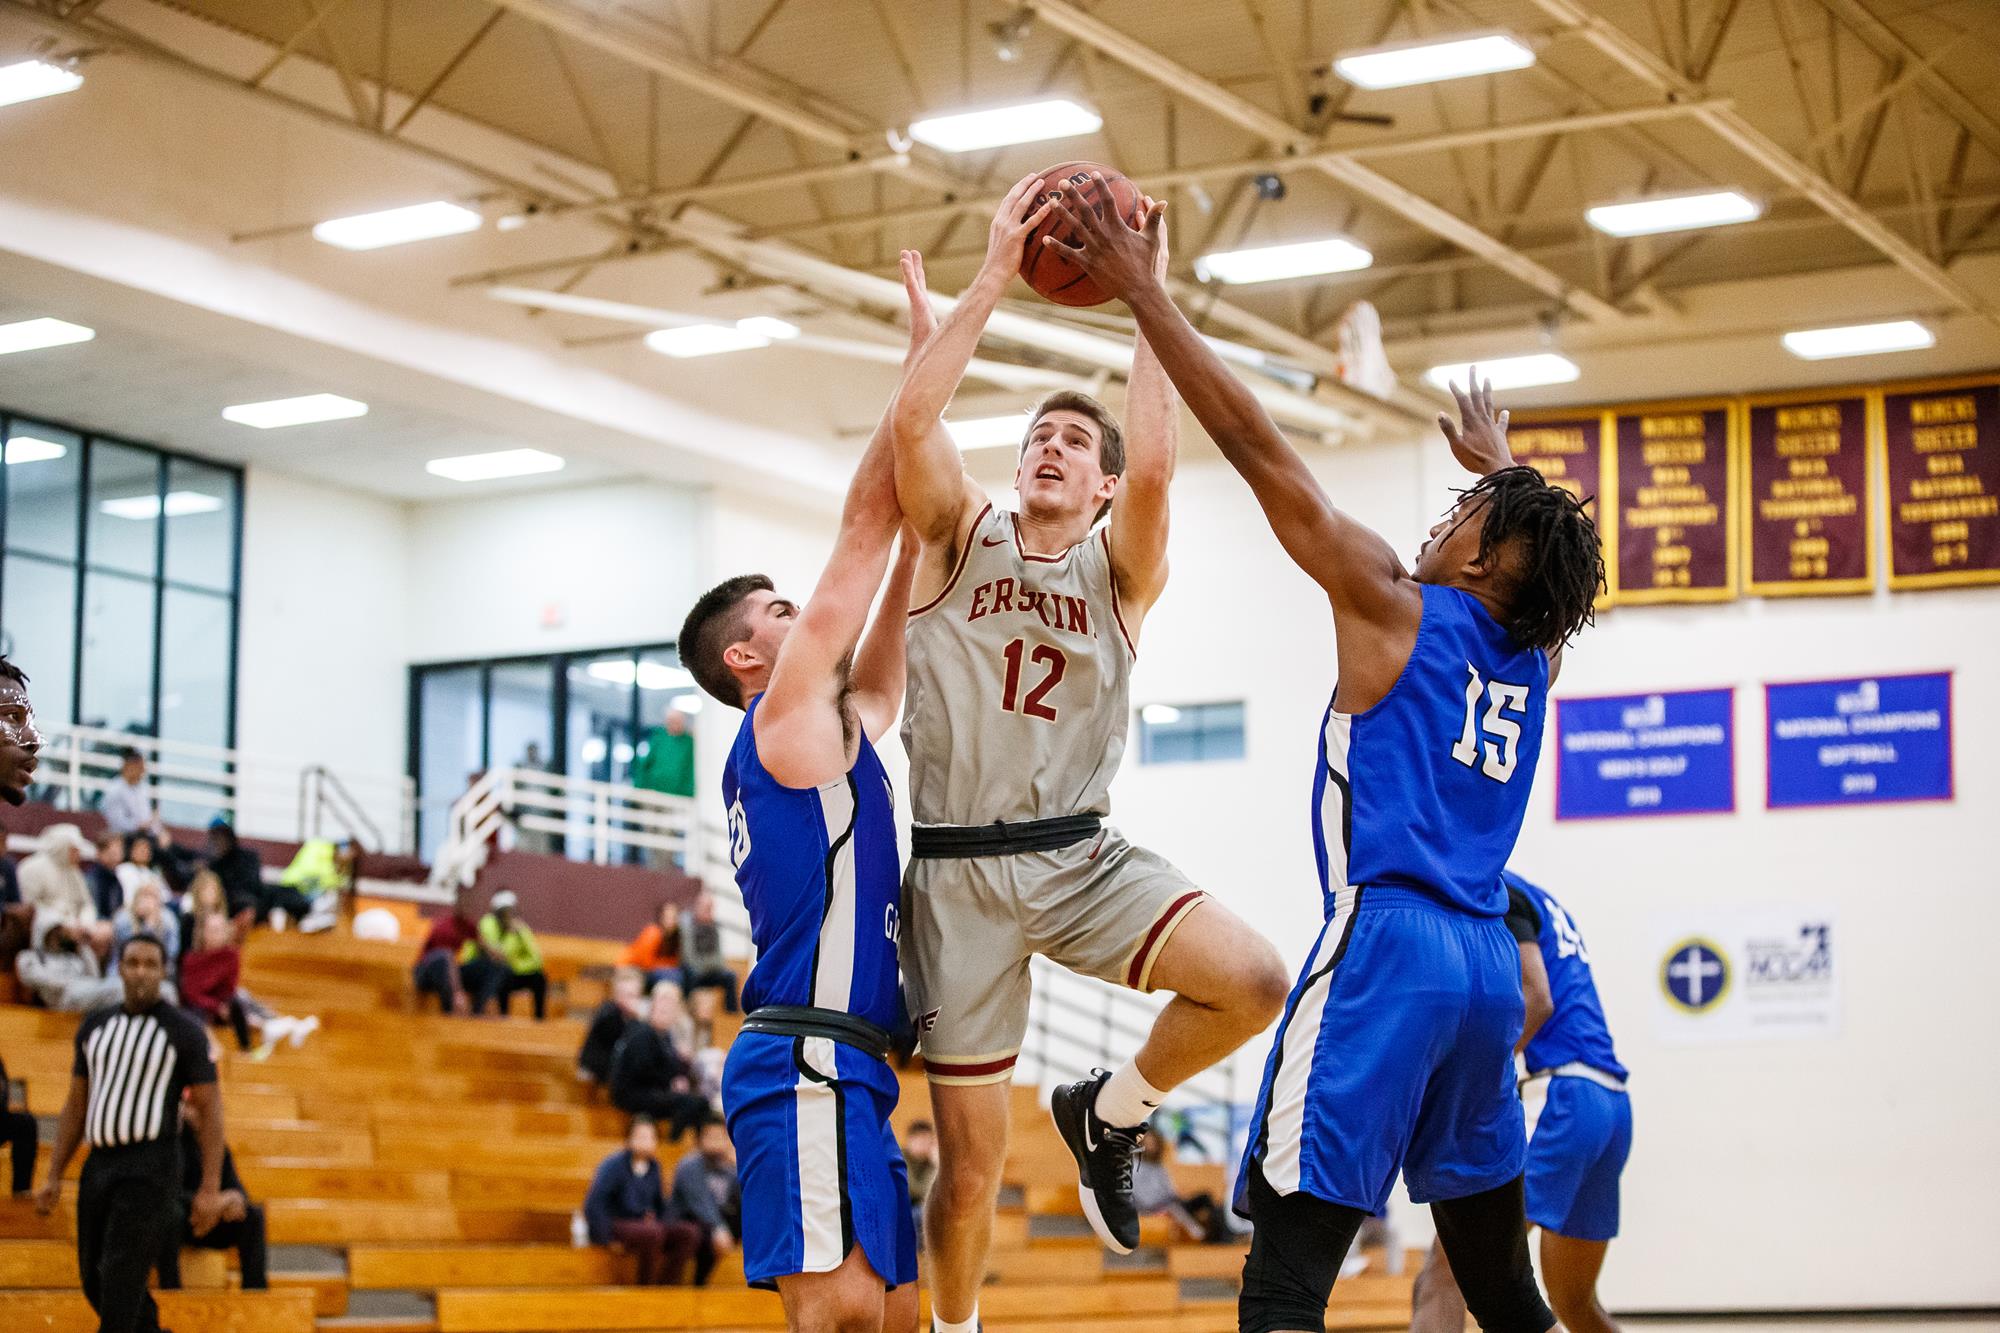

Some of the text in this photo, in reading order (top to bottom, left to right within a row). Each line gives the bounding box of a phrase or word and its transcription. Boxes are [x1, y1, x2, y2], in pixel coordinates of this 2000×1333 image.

[967, 576, 1098, 639] ERSKIN
[1001, 637, 1068, 724] 12
[1451, 659, 1530, 784] 15
